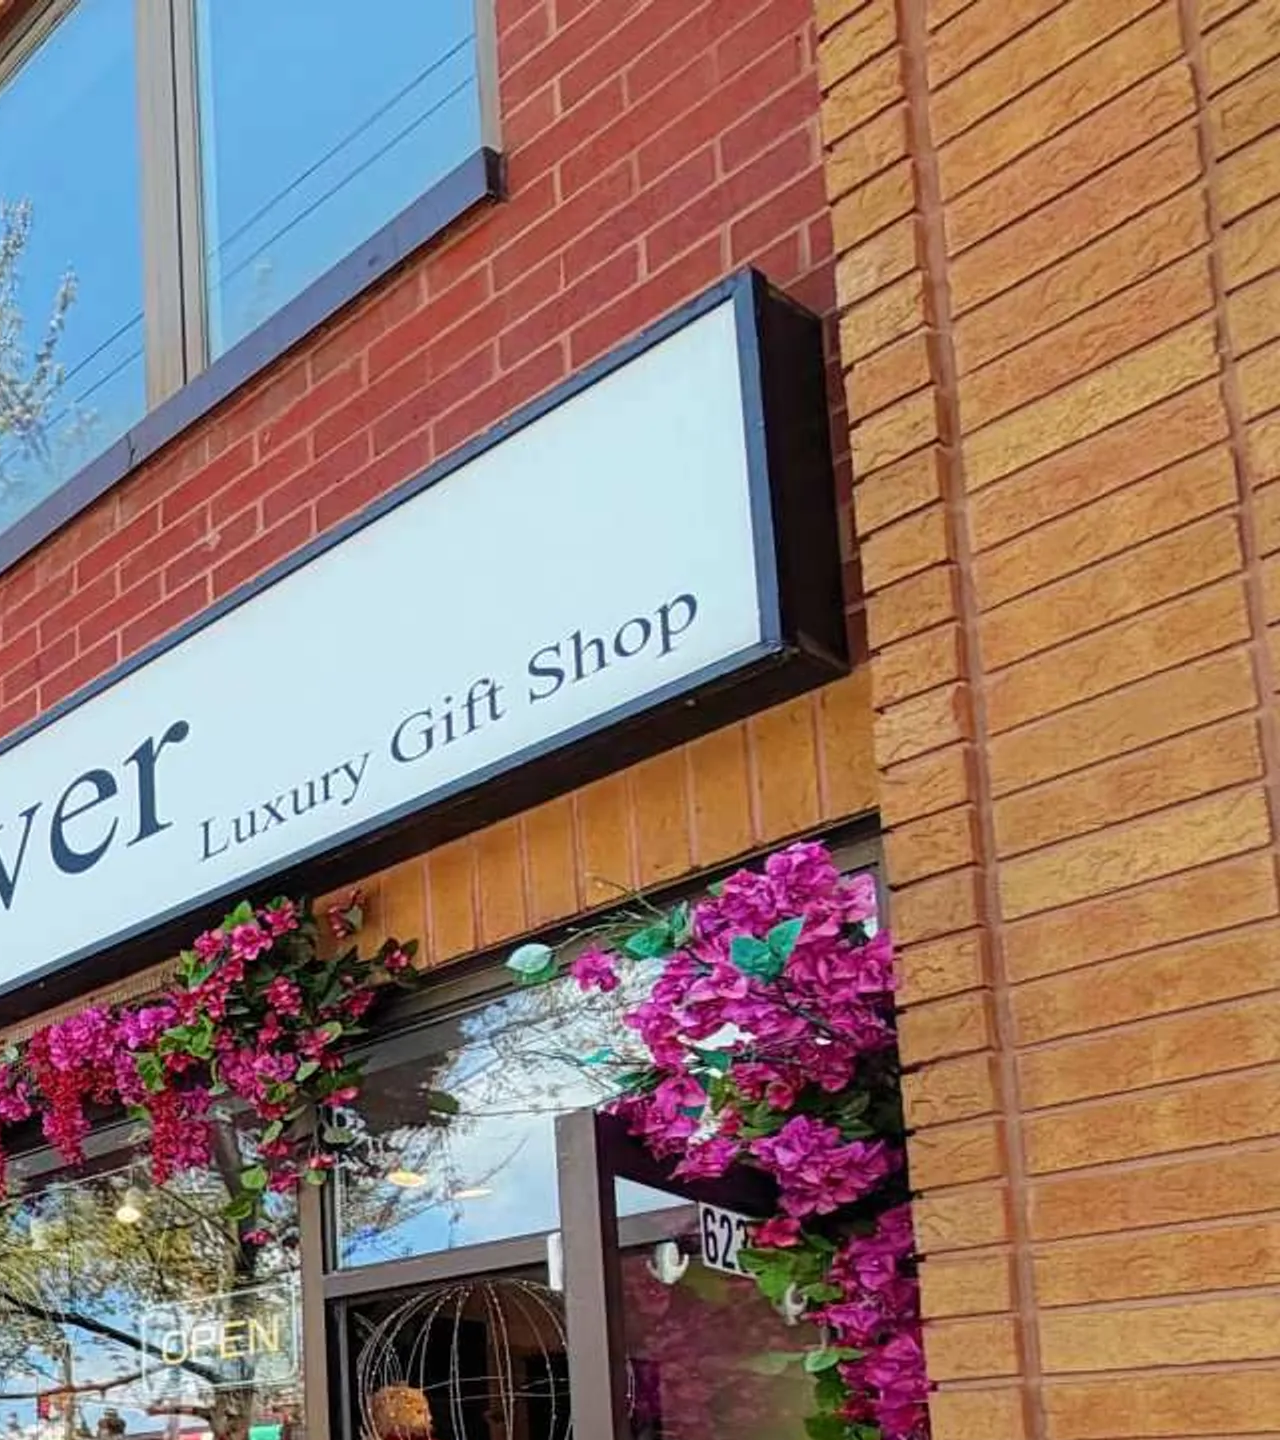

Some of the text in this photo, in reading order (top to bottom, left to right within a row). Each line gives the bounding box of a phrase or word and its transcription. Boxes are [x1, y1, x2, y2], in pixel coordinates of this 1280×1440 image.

[198, 592, 698, 863] Luxury Gift Shop
[161, 1313, 280, 1366] OPEN
